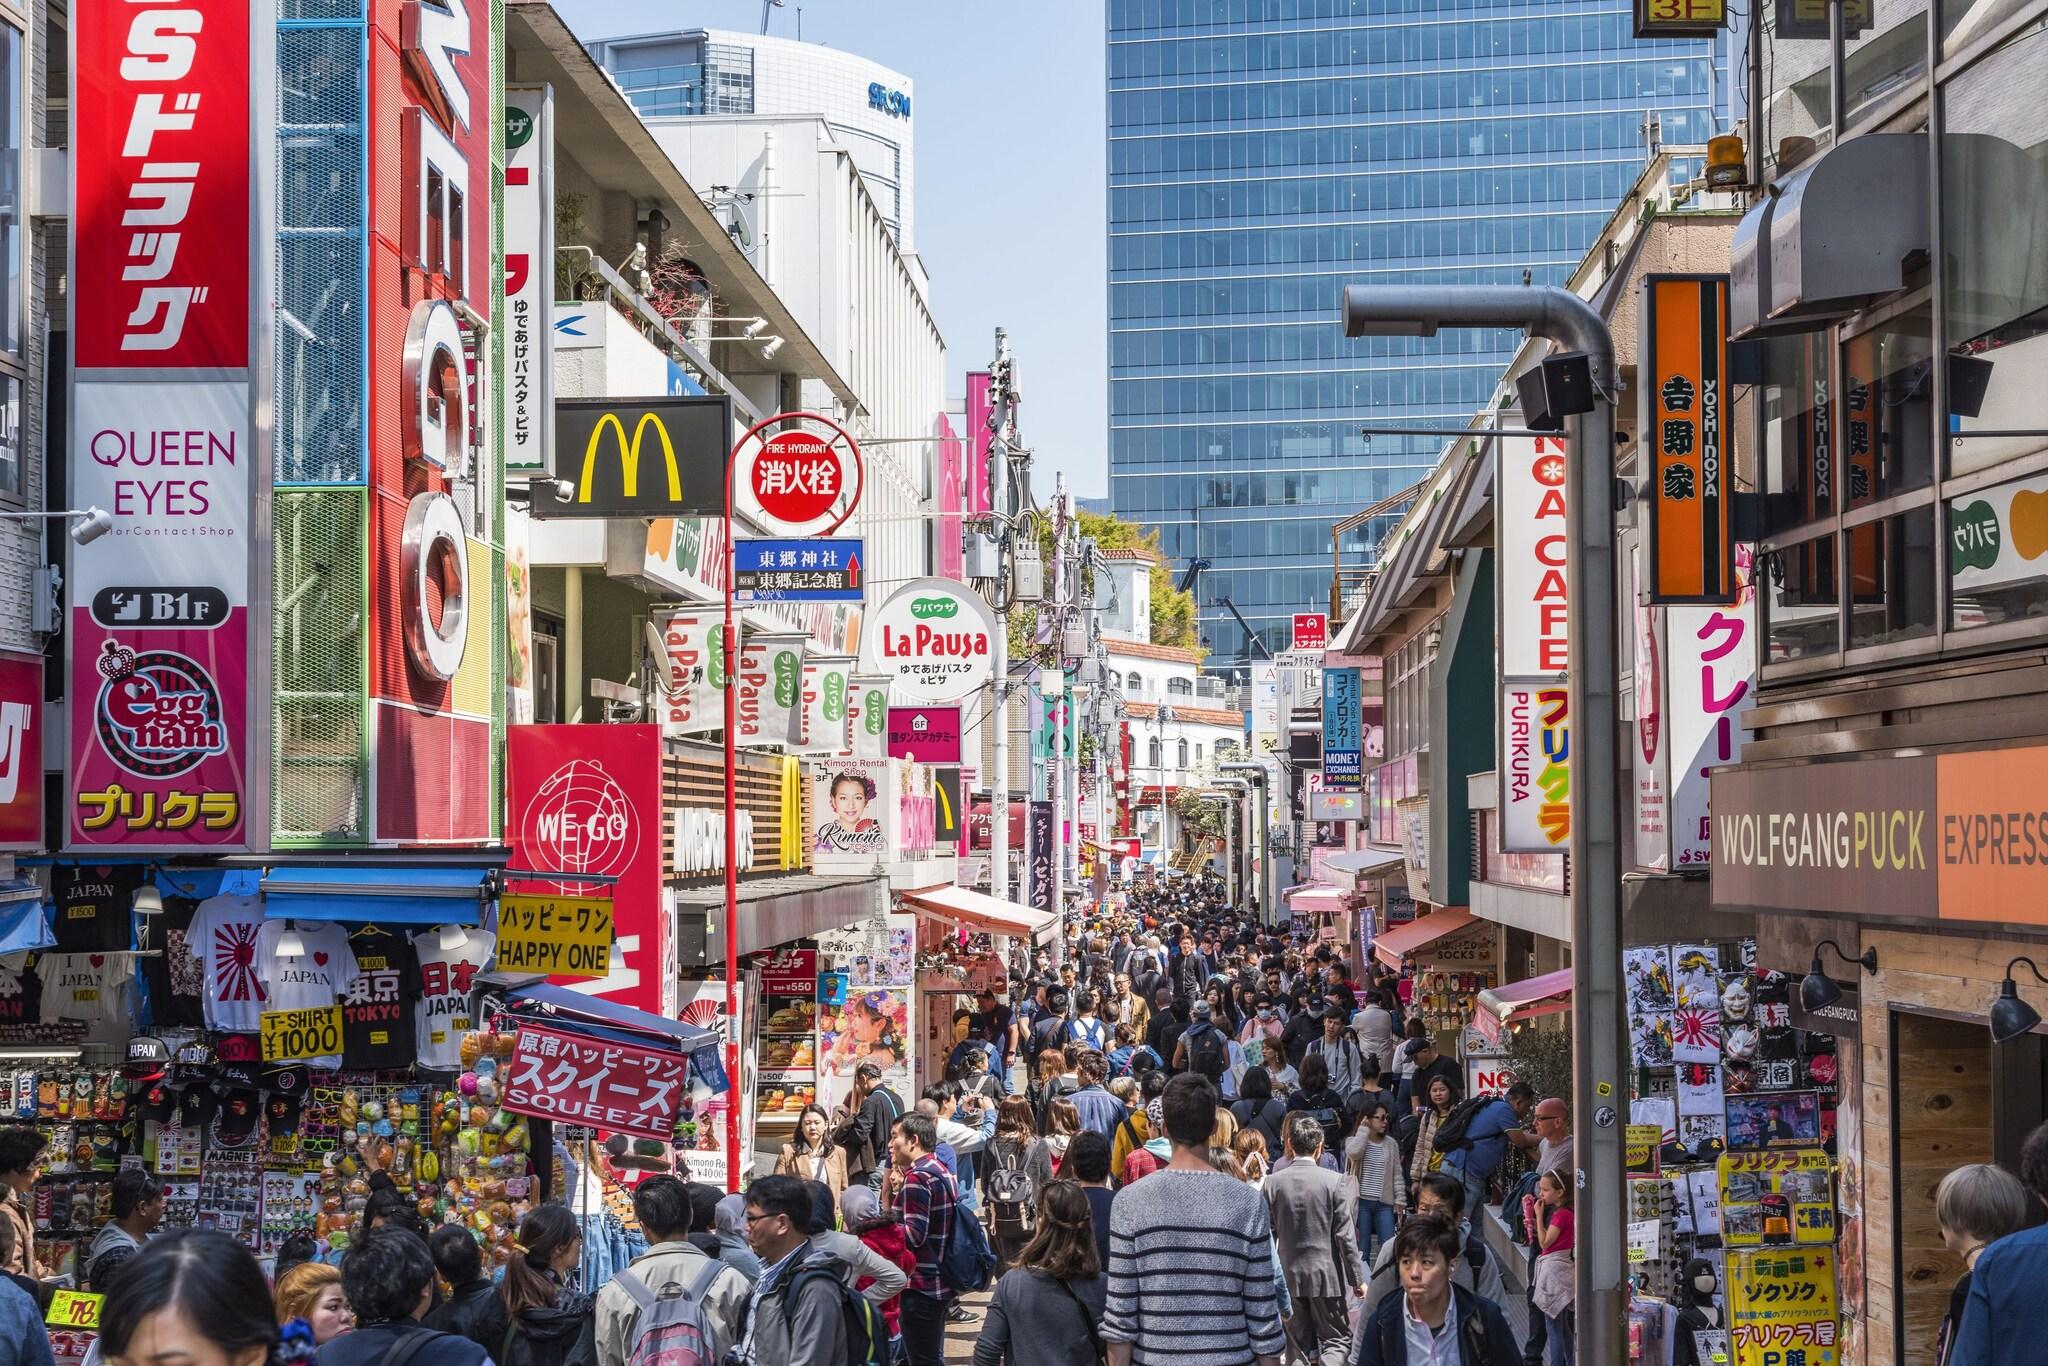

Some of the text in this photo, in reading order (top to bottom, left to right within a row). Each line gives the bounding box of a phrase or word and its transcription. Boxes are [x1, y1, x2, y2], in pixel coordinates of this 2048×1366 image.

[120, 0, 209, 351] Sドラッグ
[91, 429, 236, 467] QUEEN
[766, 443, 828, 454] FIRE HYDRANT
[759, 459, 836, 496] 消火栓
[115, 480, 210, 516] EYES
[758, 550, 839, 568] 東郷神社
[758, 571, 843, 590] 東郷記念館
[1350, 673, 1358, 699] Rental
[1336, 673, 1348, 748] コインロッカー
[1325, 753, 1360, 765] MONEY
[1511, 691, 1530, 803] PURIKURA
[824, 759, 887, 767] Kimono Rental
[844, 768, 867, 778] Shop
[1325, 765, 1360, 774] EXCHANGE
[1720, 811, 1850, 870] WOLFGANG
[1854, 809, 1927, 871] PUCK
[1944, 811, 2048, 866] EXPRESS
[67, 884, 115, 900] JAPAN
[502, 903, 610, 935] ハッピーワン
[499, 943, 609, 971] HAPPY ONE
[1437, 950, 1475, 960] SOCKS
[59, 974, 104, 988] JAPAN
[280, 970, 331, 987] JAPAN
[344, 966, 401, 1007] 東京
[421, 958, 480, 998] 日本
[265, 1007, 335, 1030] T-SHIRT
[345, 1004, 401, 1024] TOKYO
[264, 1024, 338, 1059] ¥1000
[518, 1031, 683, 1079] 原宿ハッピーワン
[511, 1055, 679, 1116] スクイーズ
[507, 1087, 671, 1135] SQUEEZE
[207, 1151, 258, 1162] MAGNET
[1745, 1281, 1817, 1302] ゾクゾク
[68, 1299, 97, 1325] 78
[1731, 1320, 1836, 1350] プリクラ屋
